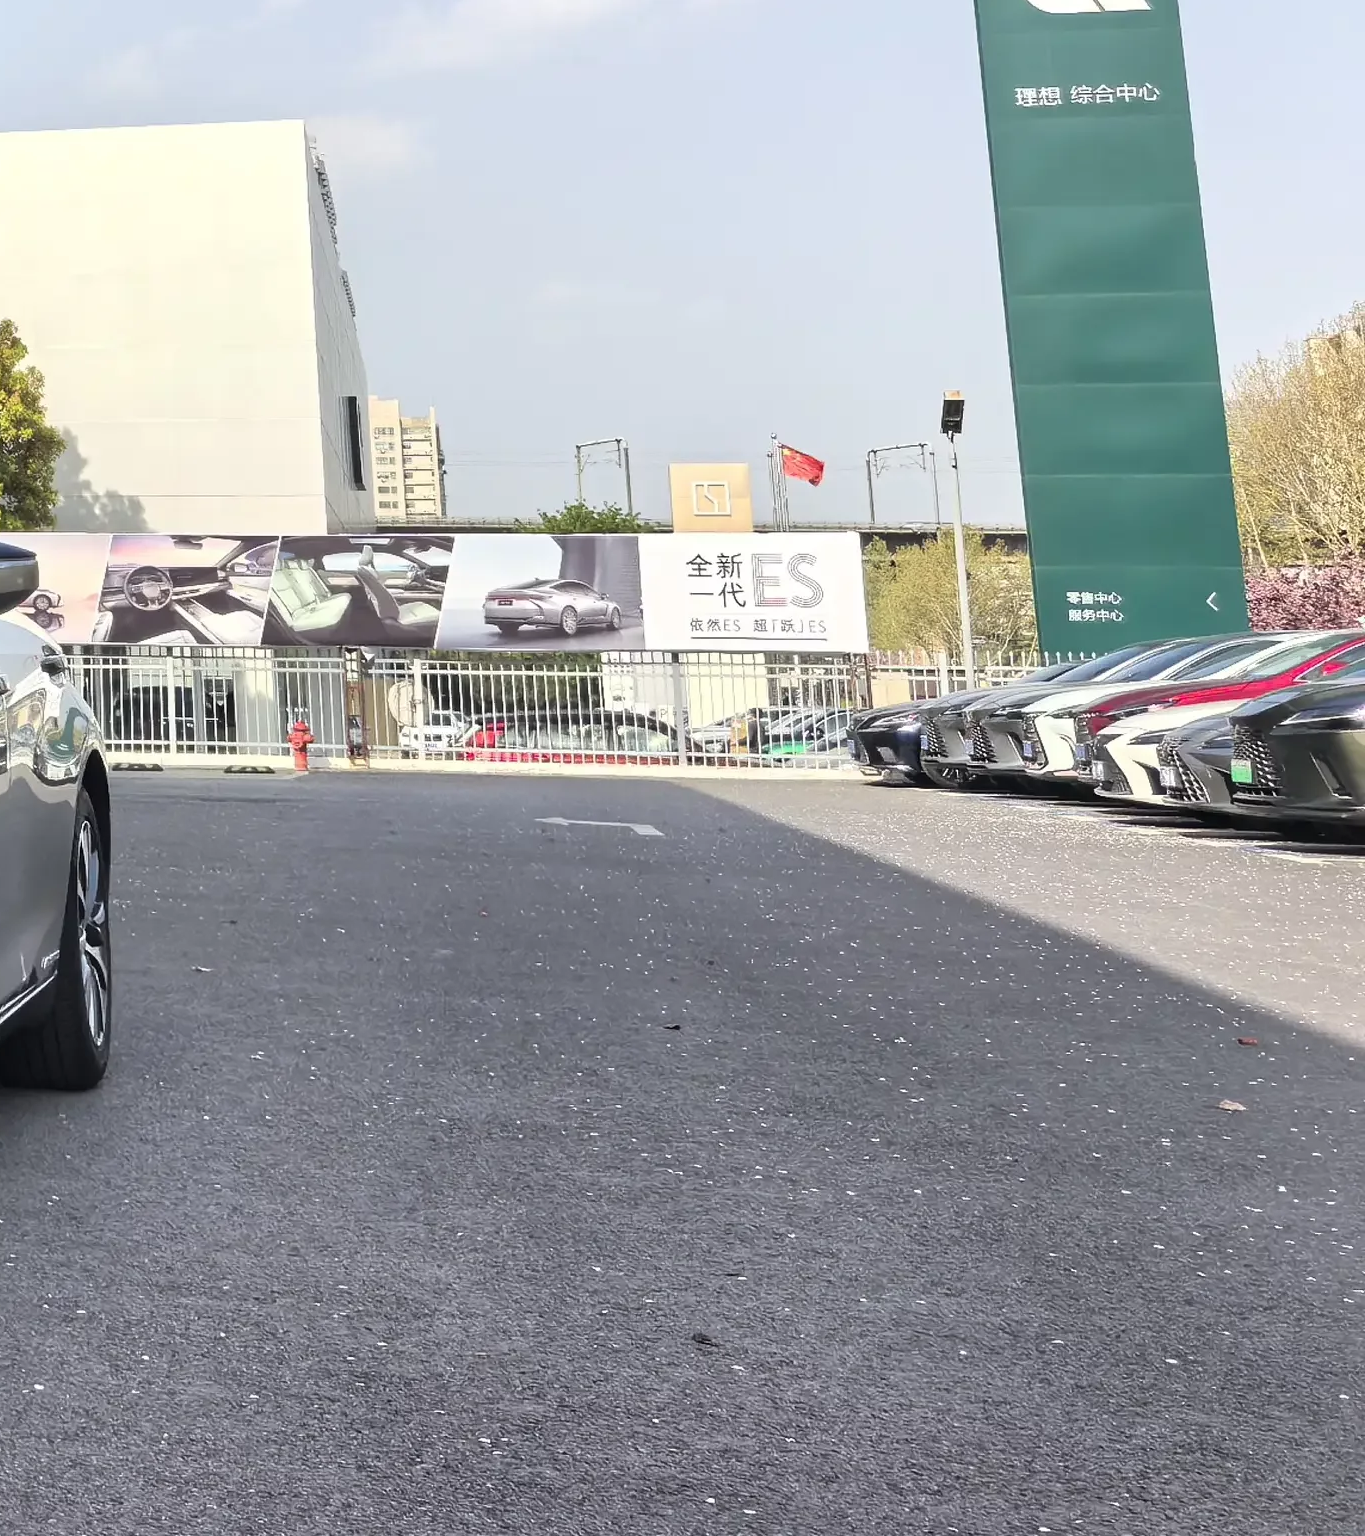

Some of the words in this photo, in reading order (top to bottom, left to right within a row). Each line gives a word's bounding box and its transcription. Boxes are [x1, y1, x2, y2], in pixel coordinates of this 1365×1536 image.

[1014, 86, 1063, 107] 理想
[1069, 82, 1161, 105] 综合中心
[686, 553, 743, 579] 全新
[751, 553, 825, 609] ES
[689, 582, 747, 608] 一代
[690, 617, 742, 633] 依然ES
[1068, 609, 1125, 622] 服务中心
